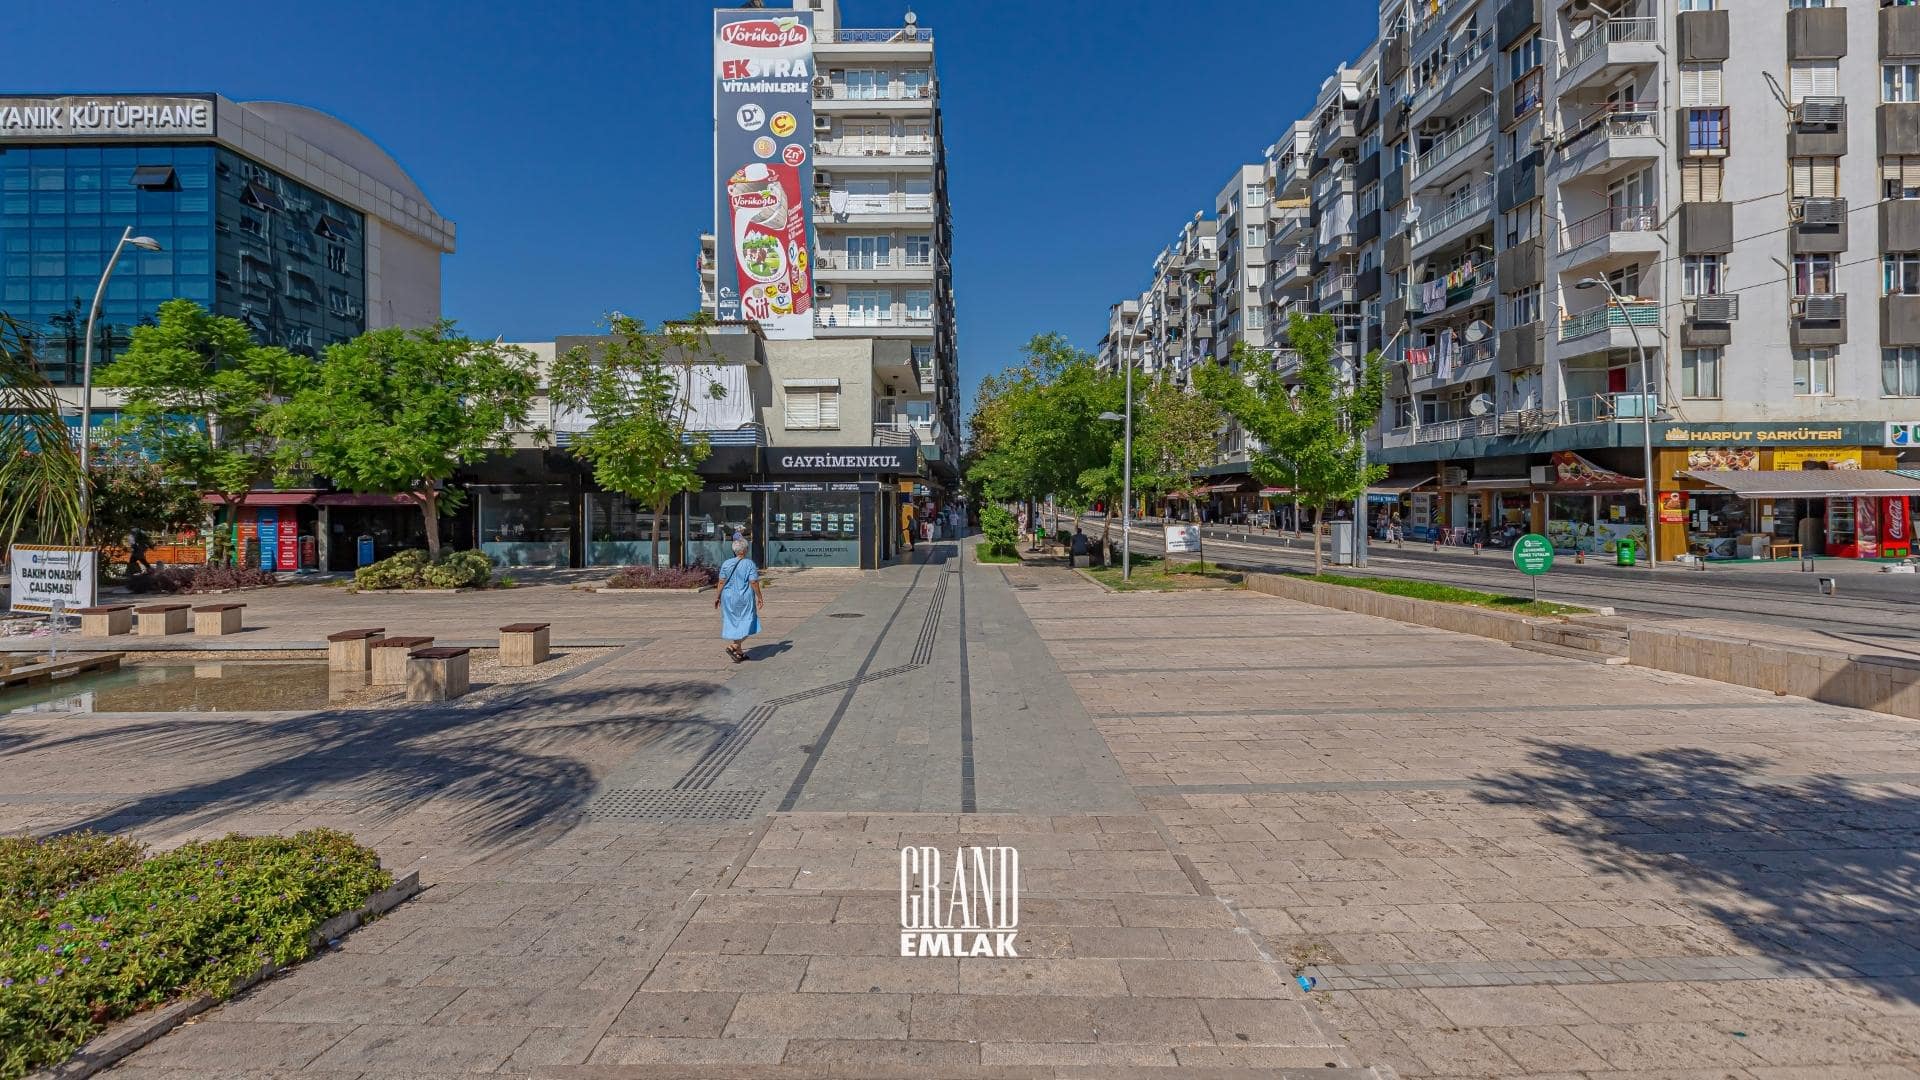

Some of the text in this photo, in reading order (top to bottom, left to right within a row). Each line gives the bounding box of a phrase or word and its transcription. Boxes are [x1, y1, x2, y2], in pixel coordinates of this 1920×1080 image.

[722, 58, 808, 80] EKSTRA
[722, 80, 808, 93] VİTAMİNLERLE
[69, 101, 207, 129] KÜTÜPHANE
[744, 297, 770, 320] Süt
[1691, 427, 1842, 442] HARPUT ŞARKÜTERİ
[781, 452, 900, 468] GAYRİMENKUL
[22, 568, 82, 581] BAKIM ONARIM
[29, 582, 73, 595] ÇALIŞMASI
